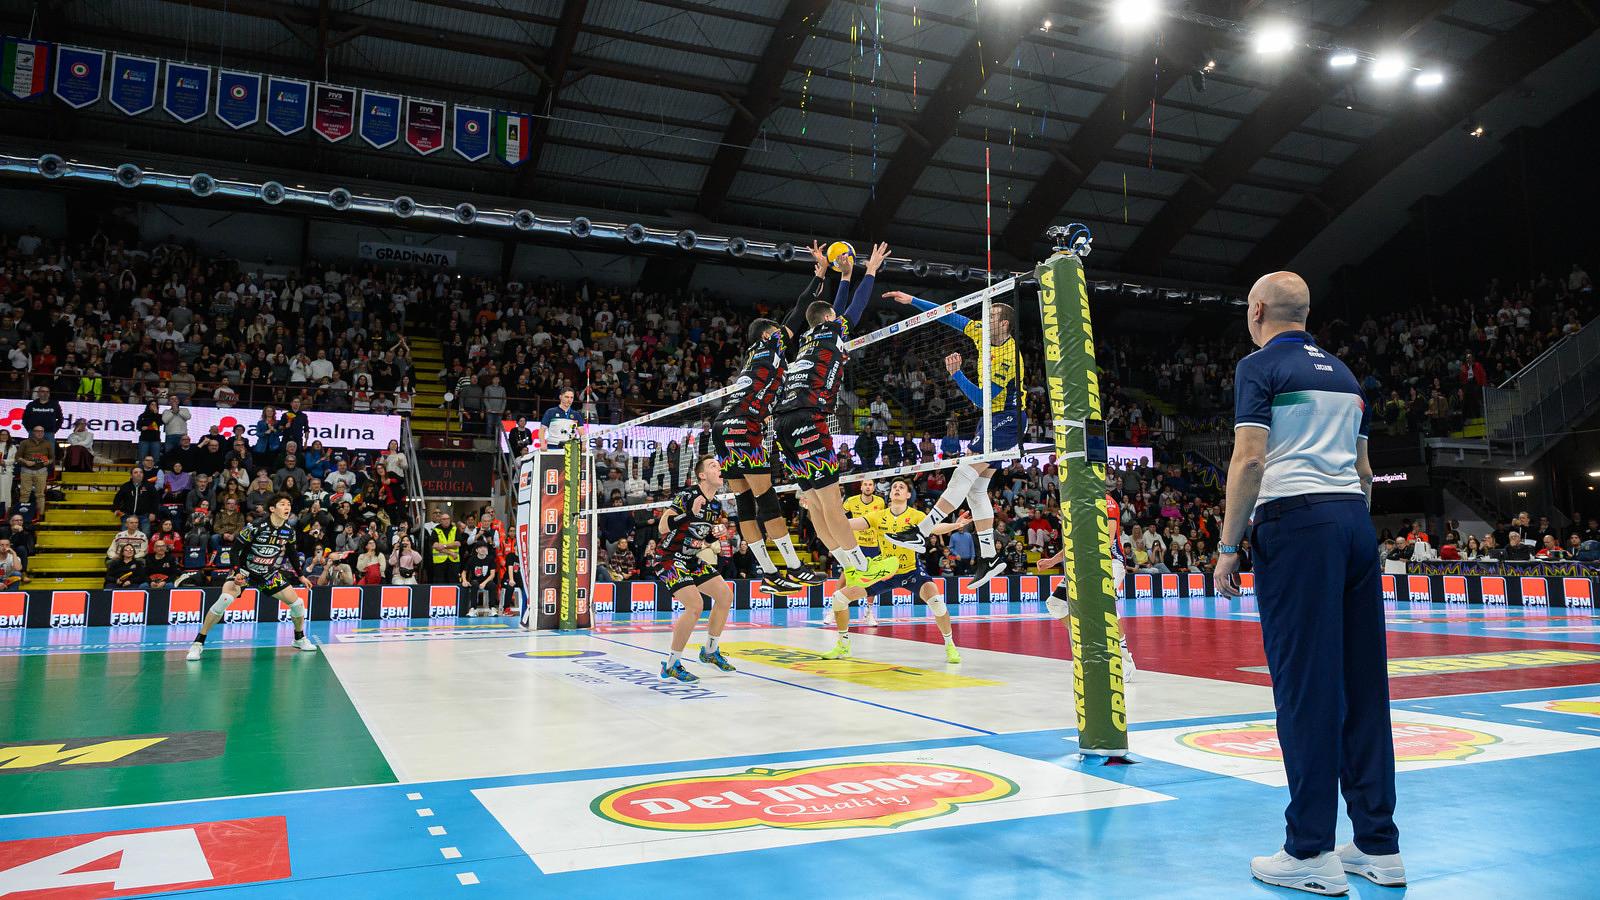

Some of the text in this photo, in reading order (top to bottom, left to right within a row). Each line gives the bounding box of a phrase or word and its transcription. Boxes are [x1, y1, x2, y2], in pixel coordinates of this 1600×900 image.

[1041, 269, 1061, 362] BANCA
[564, 444, 572, 481] BANCA
[560, 534, 570, 621] BANCA CREDEM
[1020, 592, 1037, 600] FBM
[1136, 590, 1151, 598] FBM
[1162, 590, 1178, 598] FBM
[1240, 588, 1254, 596] FBM
[1409, 592, 1429, 600] FBM
[892, 595, 912, 604] FBM
[959, 594, 977, 602] FBM
[1444, 593, 1466, 602] FBM
[1482, 594, 1505, 603] FBM
[1522, 596, 1547, 605] FBM
[1565, 597, 1591, 606] FBM
[632, 601, 655, 611] FBM
[751, 600, 771, 609] FBM
[788, 600, 808, 608] FBM
[169, 610, 200, 622] FBM
[225, 610, 255, 621] FBM
[331, 608, 359, 618] FBM
[381, 607, 408, 617] FBM
[430, 606, 456, 616] FBM
[1060, 500, 1086, 732] BANCA CREDEM
[0, 615, 24, 626] BM
[51, 614, 84, 624] FBM
[111, 612, 144, 623] FBM
[1104, 612, 1127, 732] CREDEM
[630, 767, 974, 817] Del Monte
[763, 792, 911, 818] Quality
